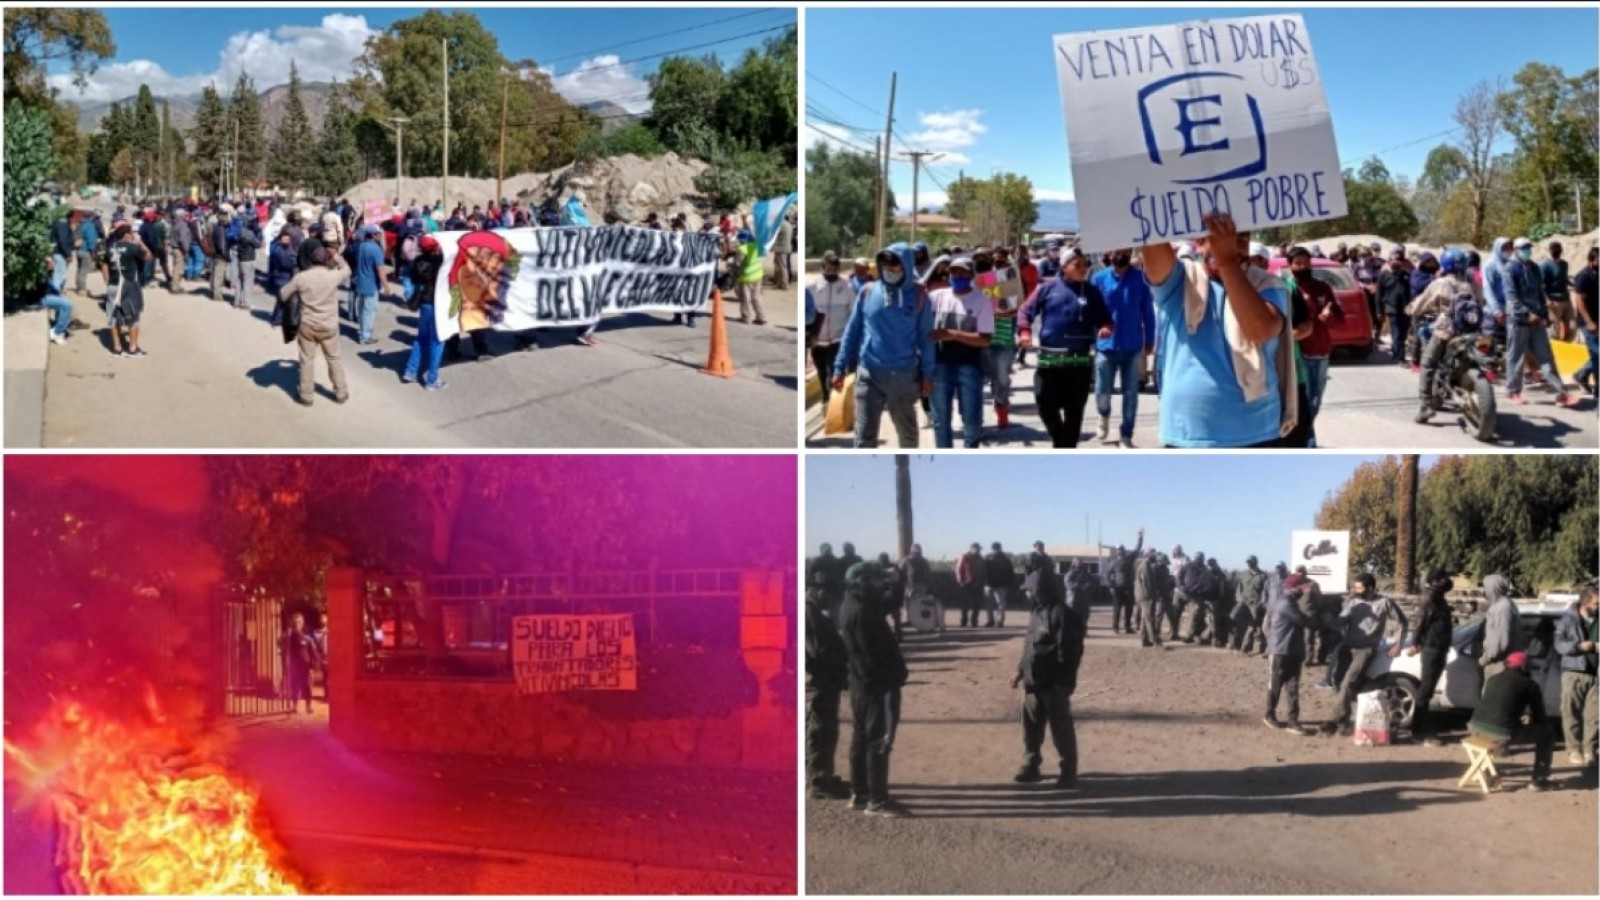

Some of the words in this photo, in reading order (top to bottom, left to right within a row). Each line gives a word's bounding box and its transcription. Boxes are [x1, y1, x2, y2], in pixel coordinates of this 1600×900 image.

[1058, 34, 1174, 81] VENTA
[1182, 25, 1221, 67] EN
[1226, 18, 1309, 64] DOLAR
[1170, 93, 1231, 158] E
[1244, 171, 1331, 225] POBRE
[536, 276, 580, 321] DEL
[515, 617, 581, 641] SUELDO
[527, 641, 573, 659] PARA
[586, 639, 622, 658] LOS
